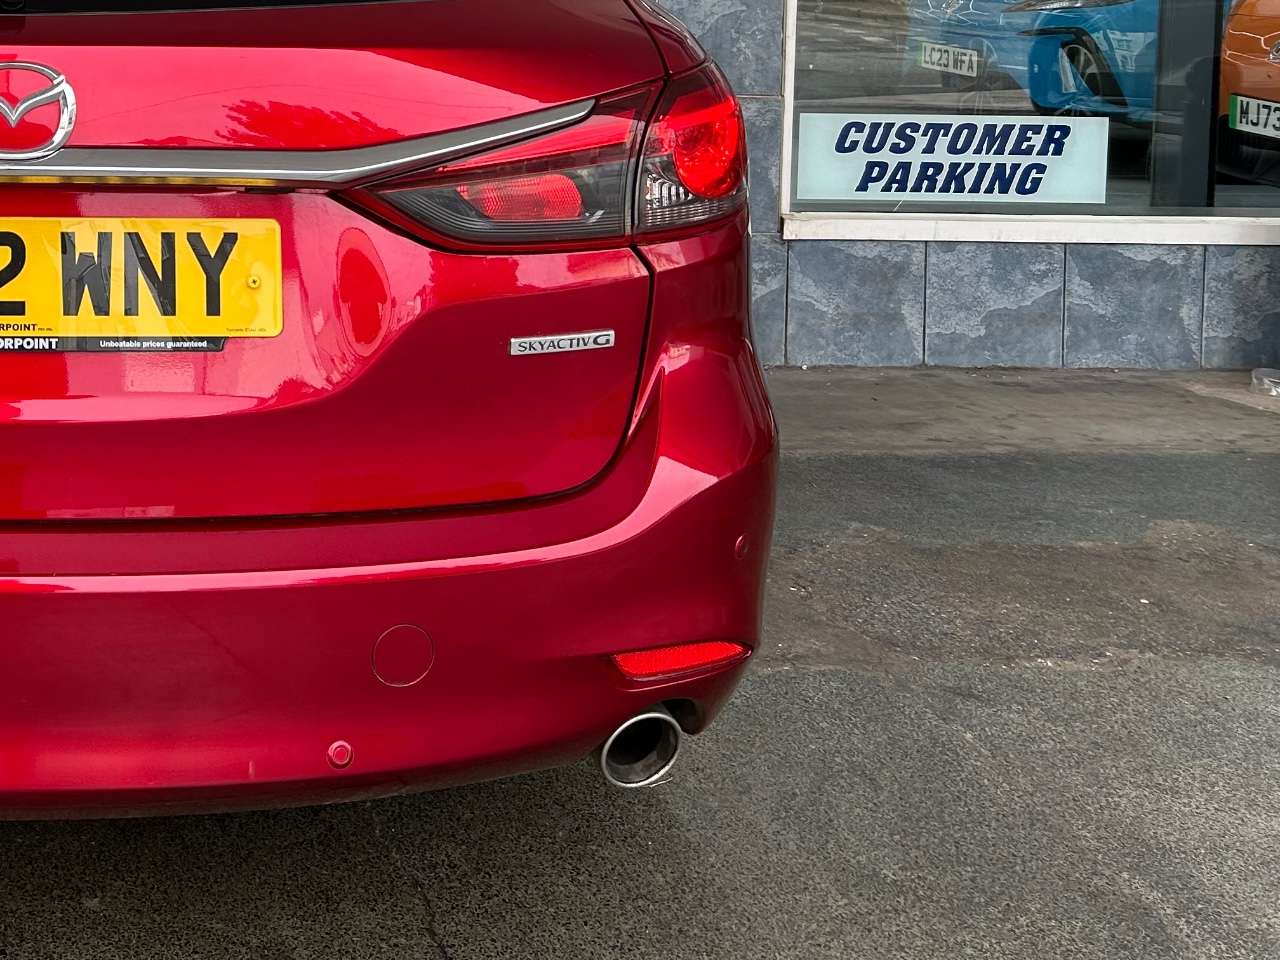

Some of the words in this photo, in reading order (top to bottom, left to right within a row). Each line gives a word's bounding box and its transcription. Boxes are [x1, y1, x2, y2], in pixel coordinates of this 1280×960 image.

[1240, 100, 1280, 131] MJ73
[835, 121, 1071, 156] CUSTOMER
[855, 160, 1048, 195] PARKING
[60, 231, 238, 317] WNY
[142, 340, 165, 348] prices
[166, 340, 208, 348] guaranteed
